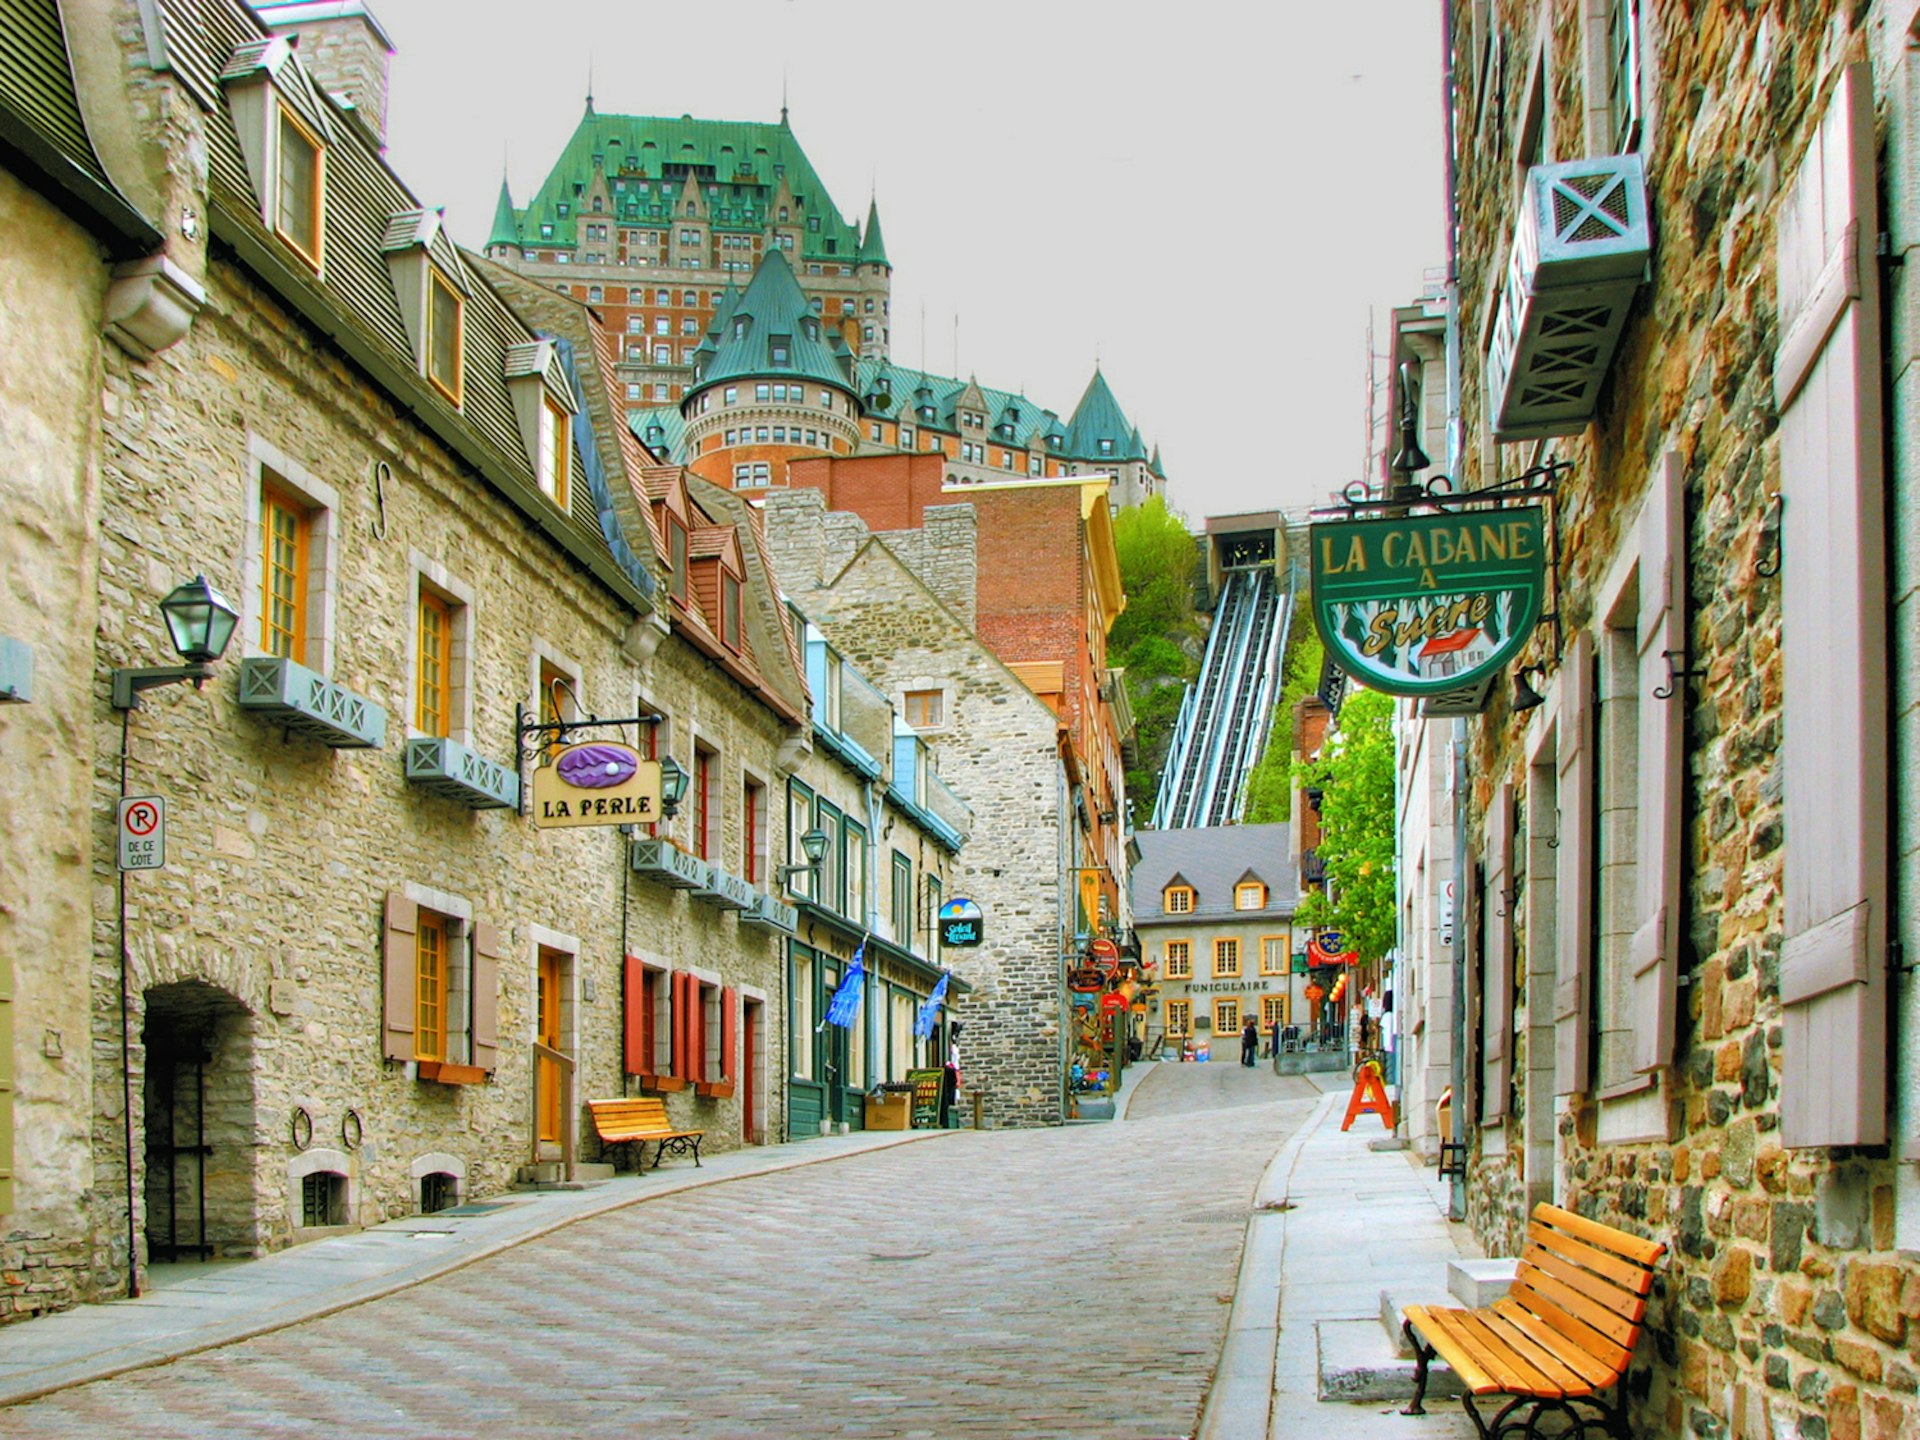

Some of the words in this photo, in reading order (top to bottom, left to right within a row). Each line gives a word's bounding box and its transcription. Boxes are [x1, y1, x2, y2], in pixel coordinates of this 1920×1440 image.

[1321, 535, 1367, 574] LA
[1382, 522, 1534, 568] CABANE
[543, 801, 571, 818] LA
[580, 796, 652, 816] PERLE
[128, 841, 140, 852] DE
[143, 840, 155, 851] CE
[1184, 980, 1269, 993] FUNICULAIRE
